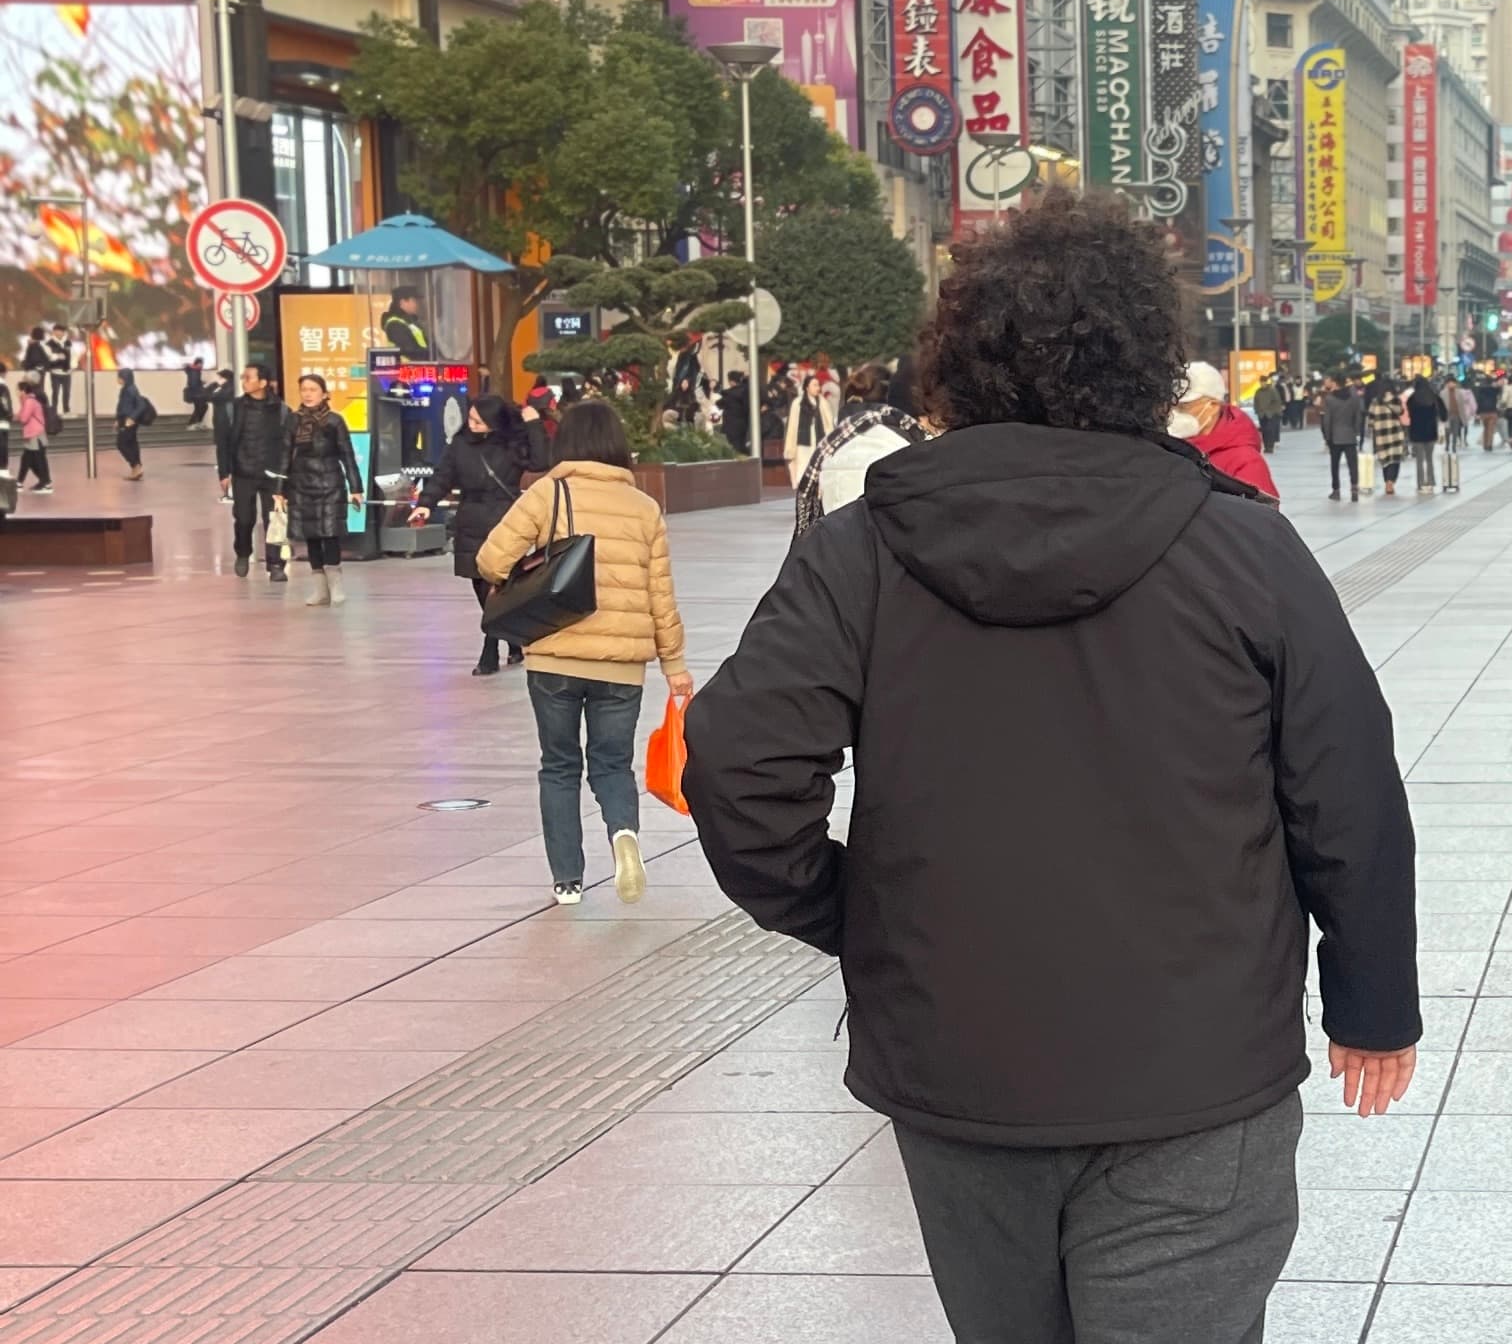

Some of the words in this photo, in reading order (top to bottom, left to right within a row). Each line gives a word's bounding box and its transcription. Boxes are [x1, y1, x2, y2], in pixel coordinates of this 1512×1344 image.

[1094, 29, 1107, 73] SINCE
[1108, 29, 1132, 194] MAOCHAN
[365, 254, 412, 264] POLICE
